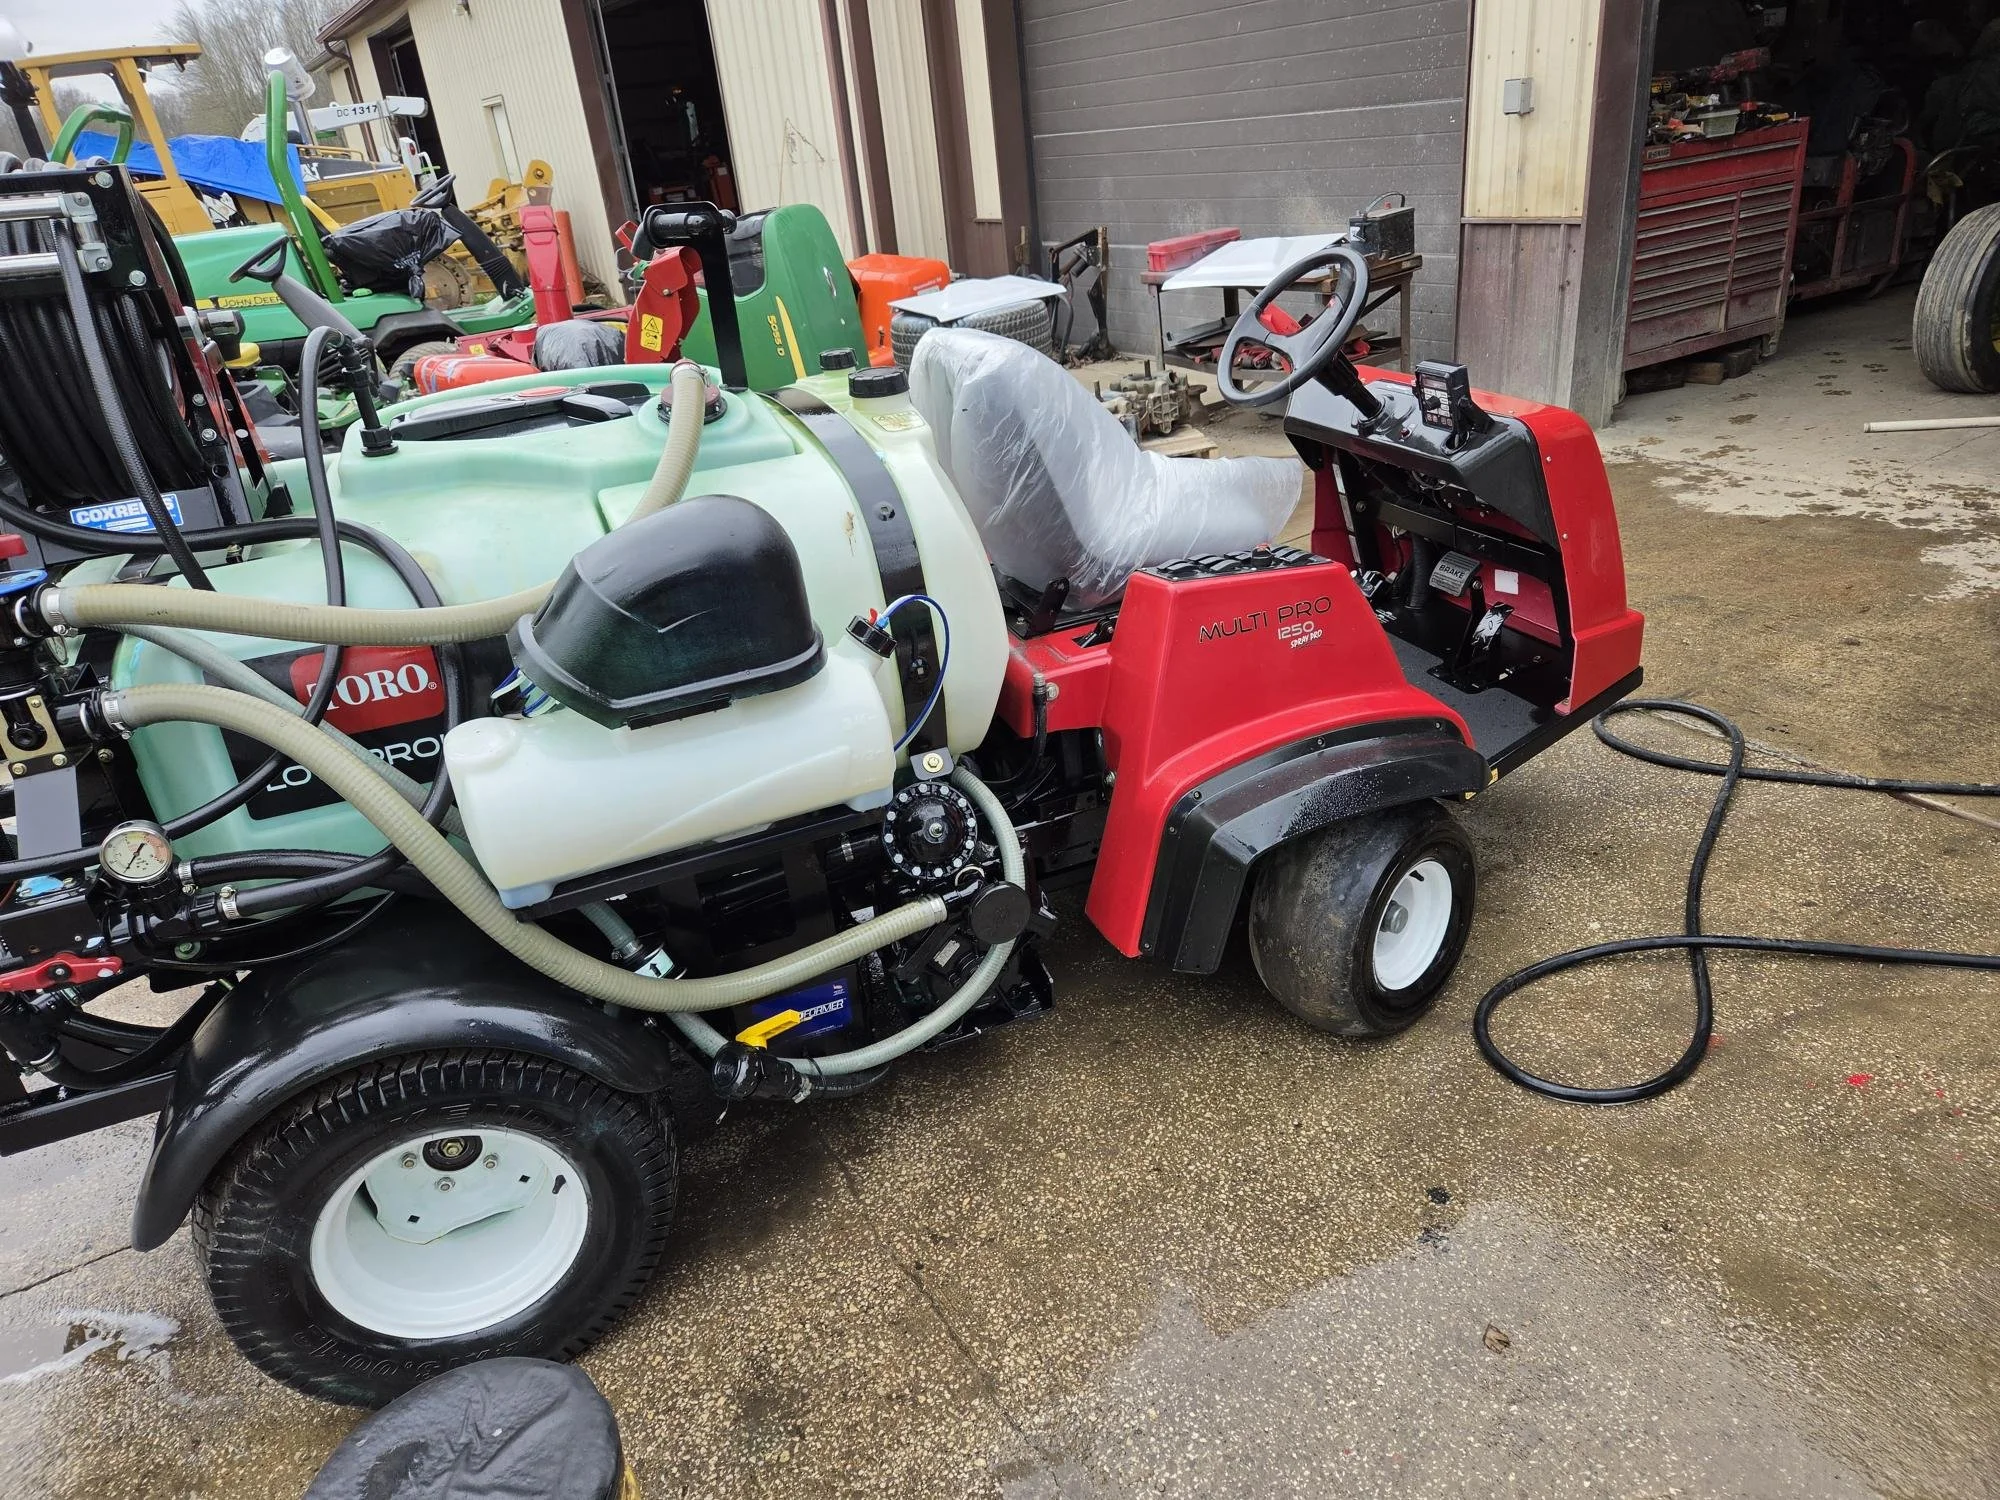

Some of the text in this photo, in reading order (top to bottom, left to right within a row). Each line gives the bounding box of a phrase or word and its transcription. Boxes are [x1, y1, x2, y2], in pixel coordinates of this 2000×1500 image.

[337, 105, 378, 118] DC 1317
[223, 298, 252, 308] JOHN
[1439, 564, 1466, 579] BRAKE
[1199, 596, 1332, 643] MULTI PRO
[1278, 620, 1315, 641] 1250
[1290, 629, 1323, 649] SPRAY PRO
